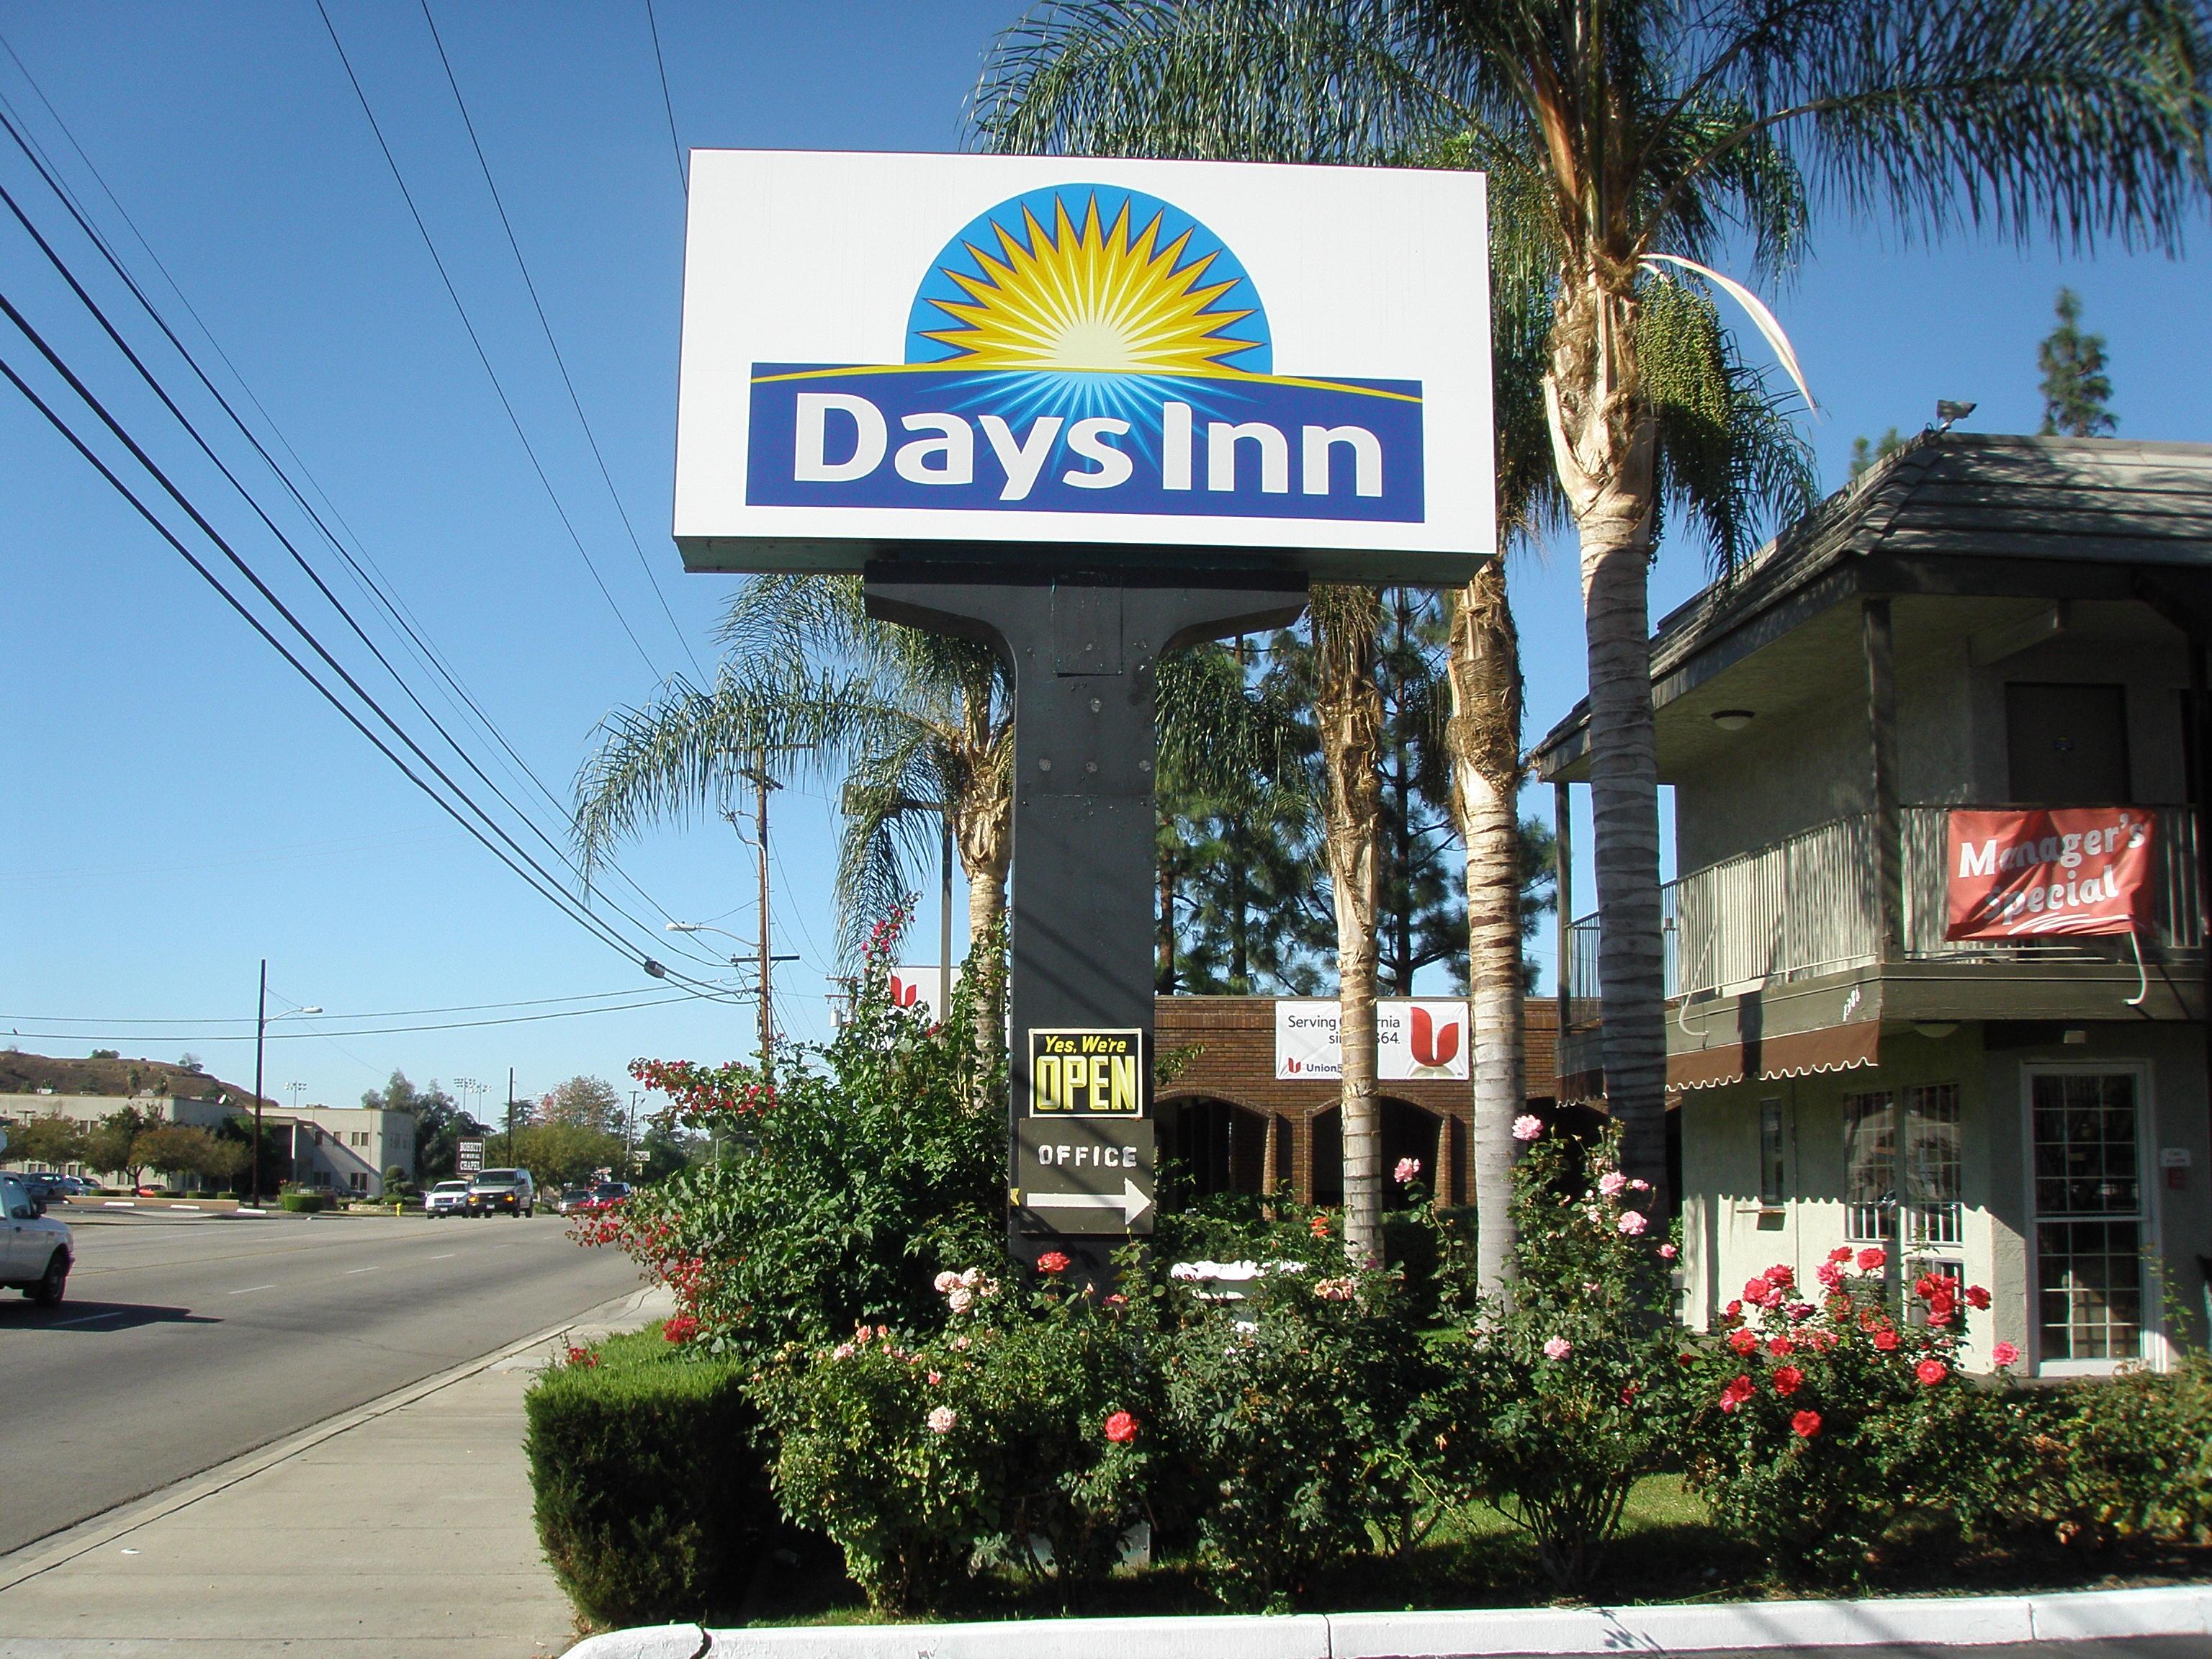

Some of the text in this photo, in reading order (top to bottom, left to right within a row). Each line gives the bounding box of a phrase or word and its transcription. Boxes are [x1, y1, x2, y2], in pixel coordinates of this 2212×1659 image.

[793, 392, 1383, 501] Days Inn
[1958, 813, 2146, 878] Manager's
[1287, 1015, 1336, 1031] Serving
[1045, 1035, 1127, 1054] Yes, We're
[1036, 1055, 1136, 1110] OPEN
[460, 1161, 481, 1171] CHAPEL
[1038, 1144, 1138, 1168] OFFICE
